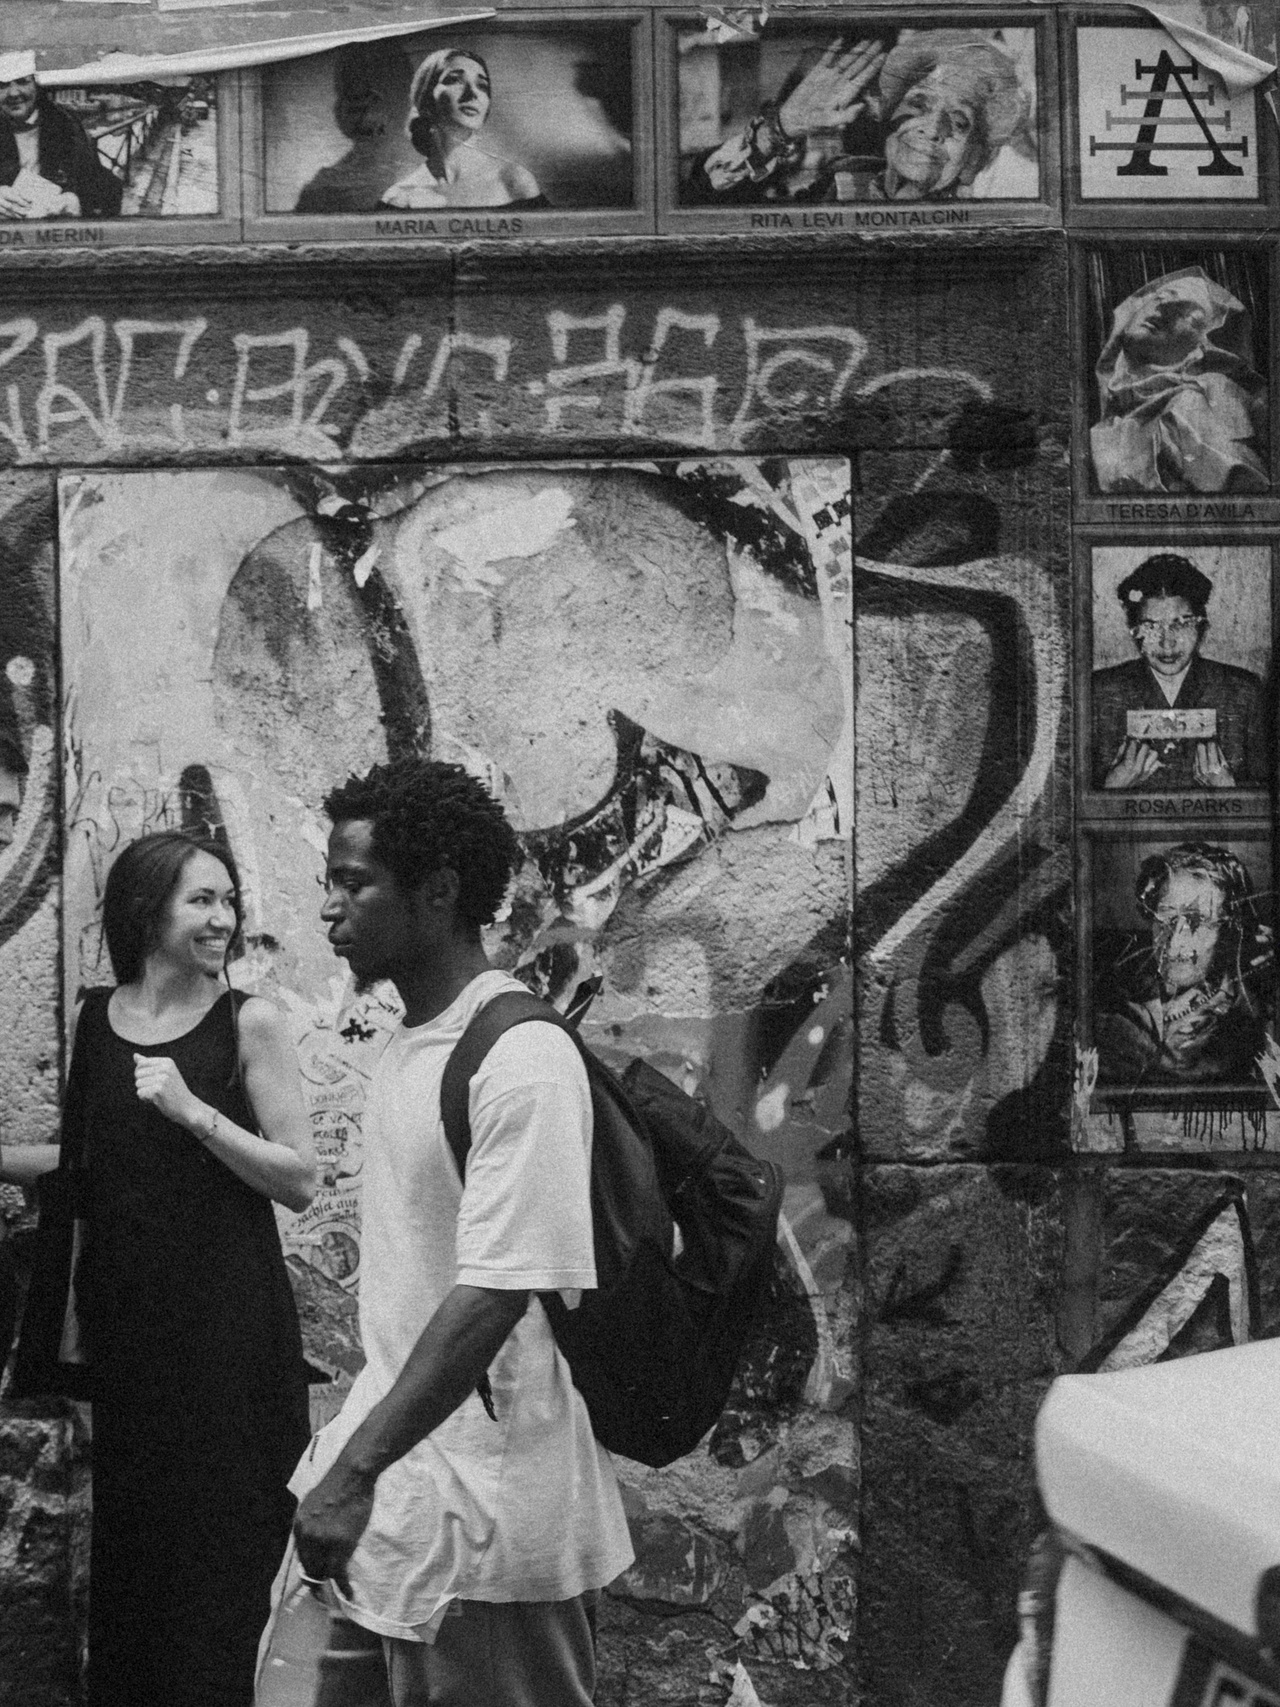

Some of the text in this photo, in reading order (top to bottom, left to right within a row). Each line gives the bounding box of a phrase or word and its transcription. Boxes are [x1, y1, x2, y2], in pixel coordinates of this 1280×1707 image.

[375, 217, 523, 235] MARIA CALLAS
[750, 209, 970, 228] RITA LEVI MONTALCINI
[35, 227, 105, 243] MERINI
[1107, 502, 1182, 519] TERESA
[1125, 798, 1243, 814] ROSA PARKS
